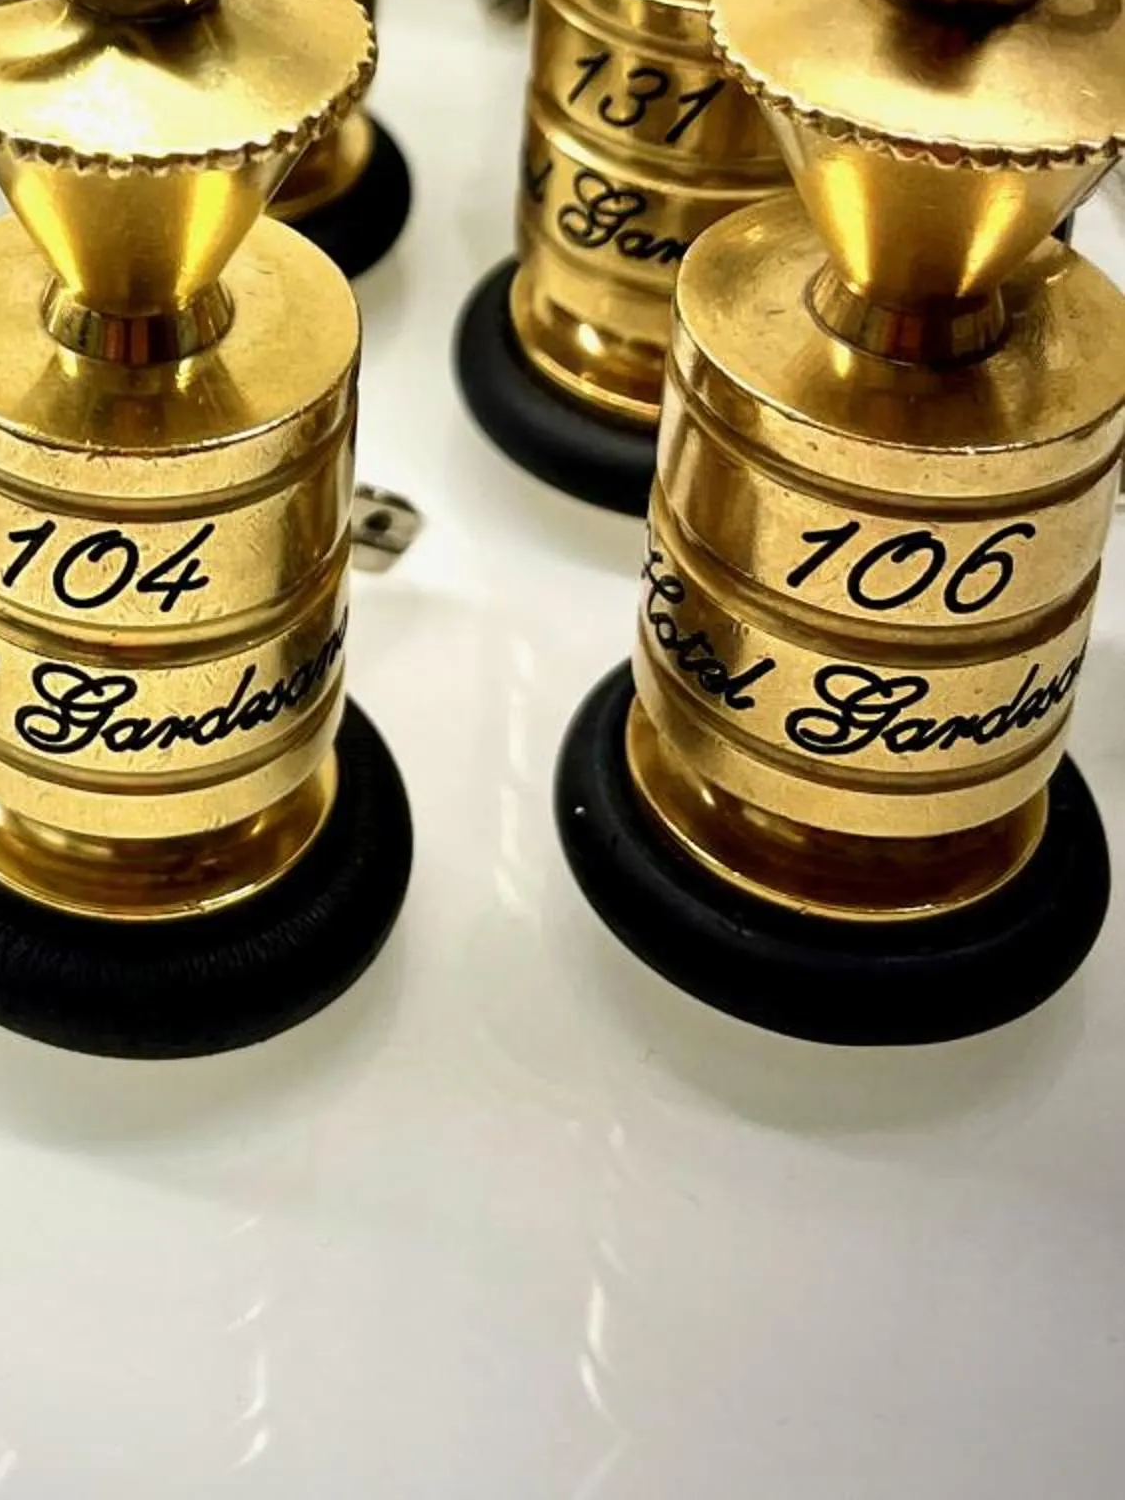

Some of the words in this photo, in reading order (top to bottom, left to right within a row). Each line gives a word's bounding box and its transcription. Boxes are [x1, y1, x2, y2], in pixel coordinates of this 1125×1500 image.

[568, 51, 725, 143] 131
[1, 519, 216, 613] 104
[786, 520, 1036, 614] 106
